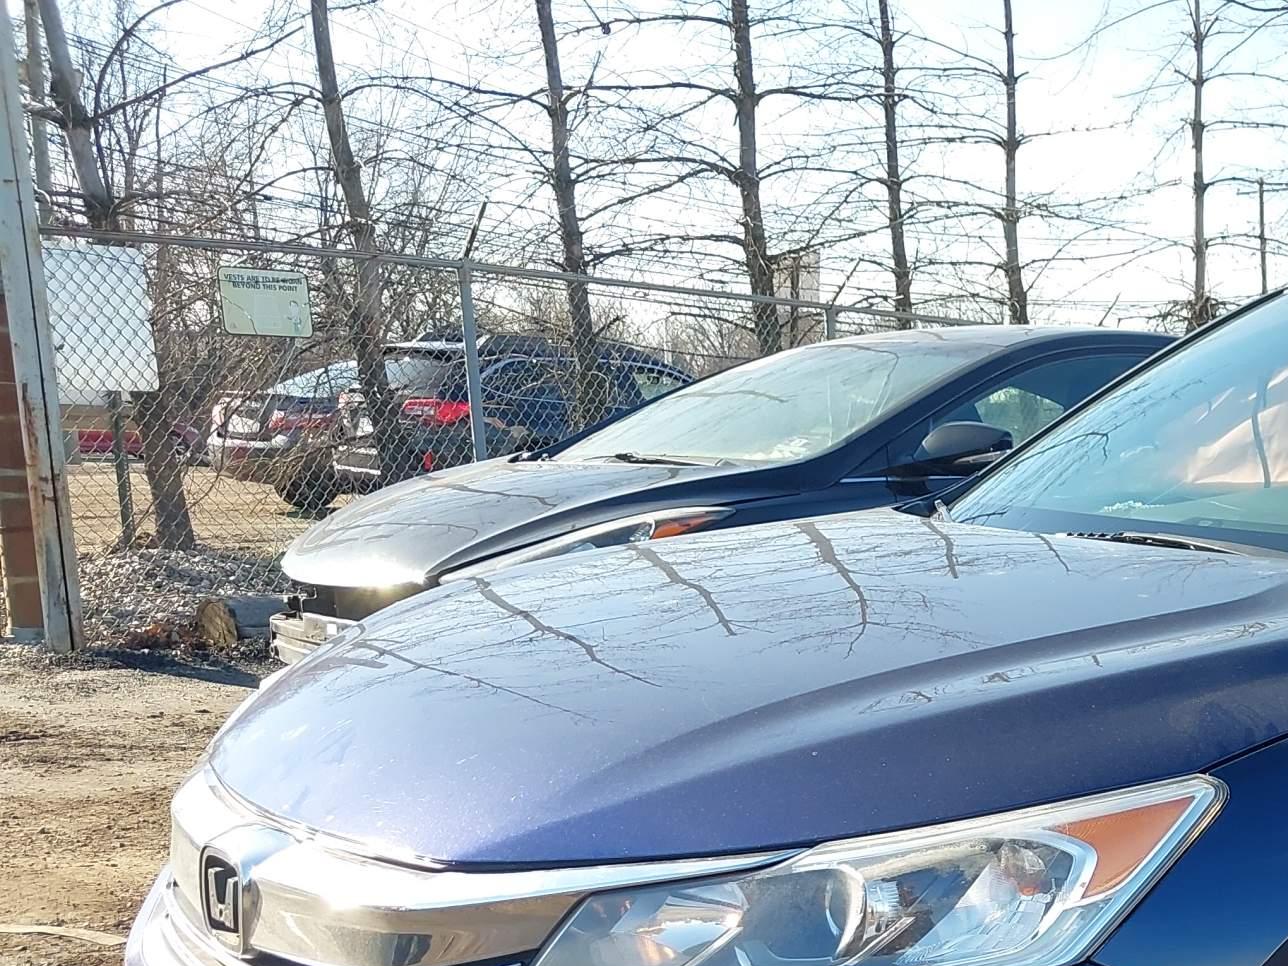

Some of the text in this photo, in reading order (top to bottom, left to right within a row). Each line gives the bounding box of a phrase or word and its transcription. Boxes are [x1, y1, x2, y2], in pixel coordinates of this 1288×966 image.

[232, 281, 298, 292] BEYOND THIS POINT
